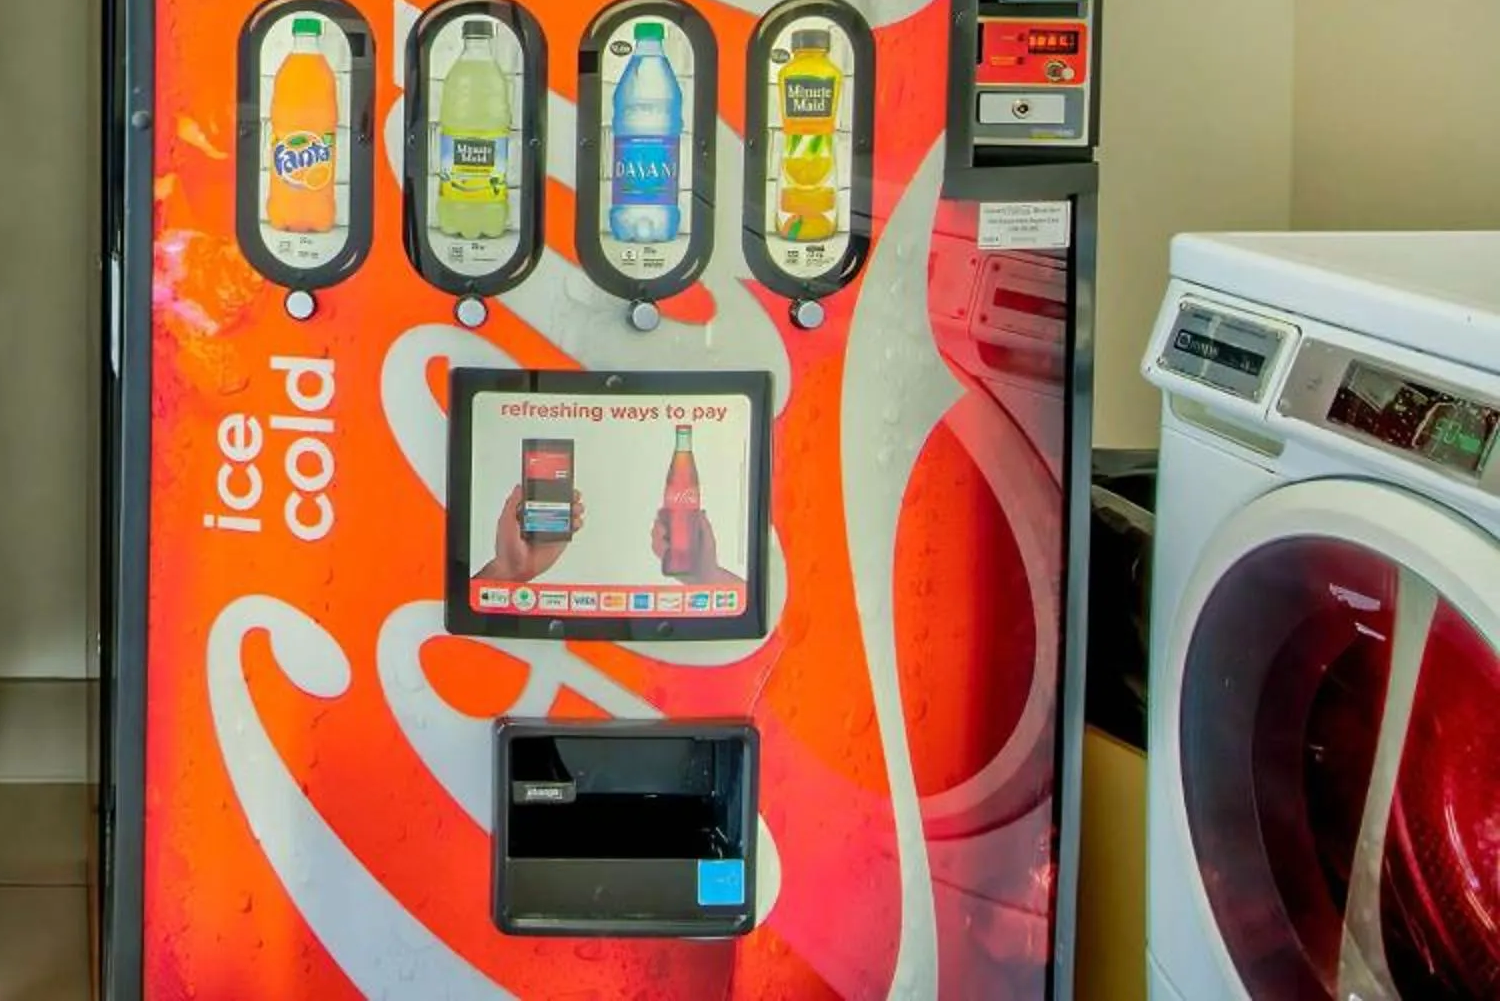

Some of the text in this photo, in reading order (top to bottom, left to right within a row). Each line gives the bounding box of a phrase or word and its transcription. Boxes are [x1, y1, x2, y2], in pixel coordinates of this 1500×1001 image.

[788, 85, 833, 100] Minute
[794, 98, 826, 112] Maid
[275, 143, 332, 176] Fanta
[501, 401, 728, 423] refreshing ways to pay
[269, 355, 336, 541] cold
[203, 412, 264, 532] ice
